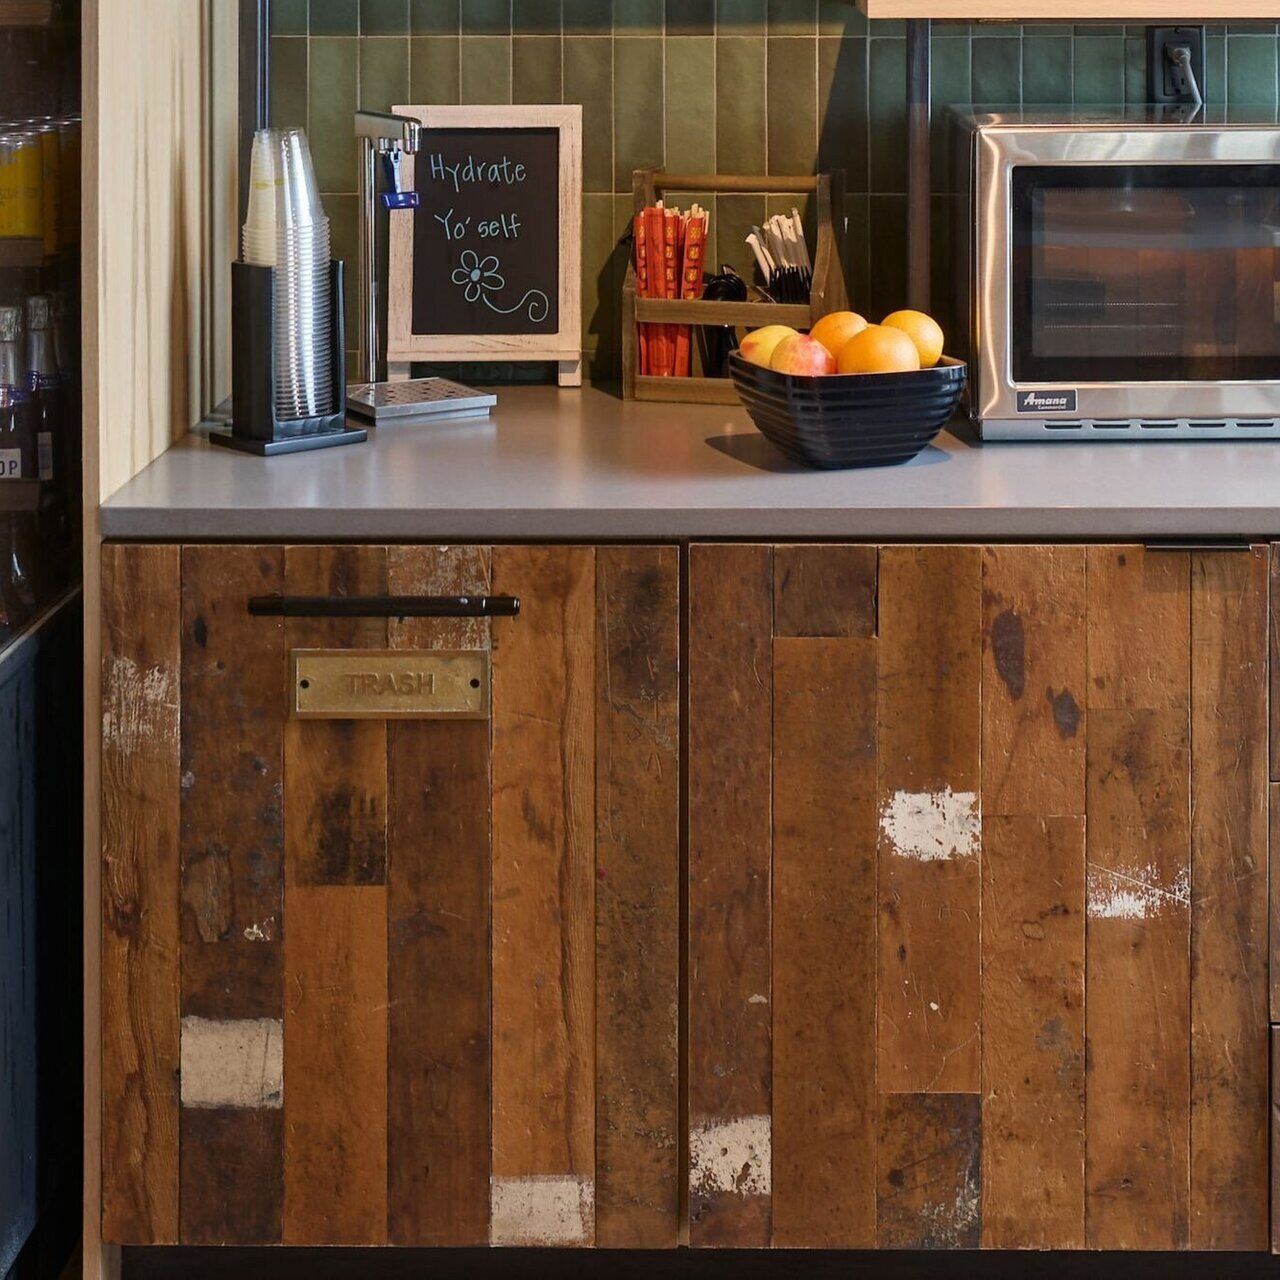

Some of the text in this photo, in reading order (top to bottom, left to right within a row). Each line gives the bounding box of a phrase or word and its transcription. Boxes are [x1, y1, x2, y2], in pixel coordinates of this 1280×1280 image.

[430, 153, 527, 193] Hydrate
[477, 212, 521, 239] self
[1023, 392, 1067, 406] Amana
[343, 671, 437, 696] TRASH
